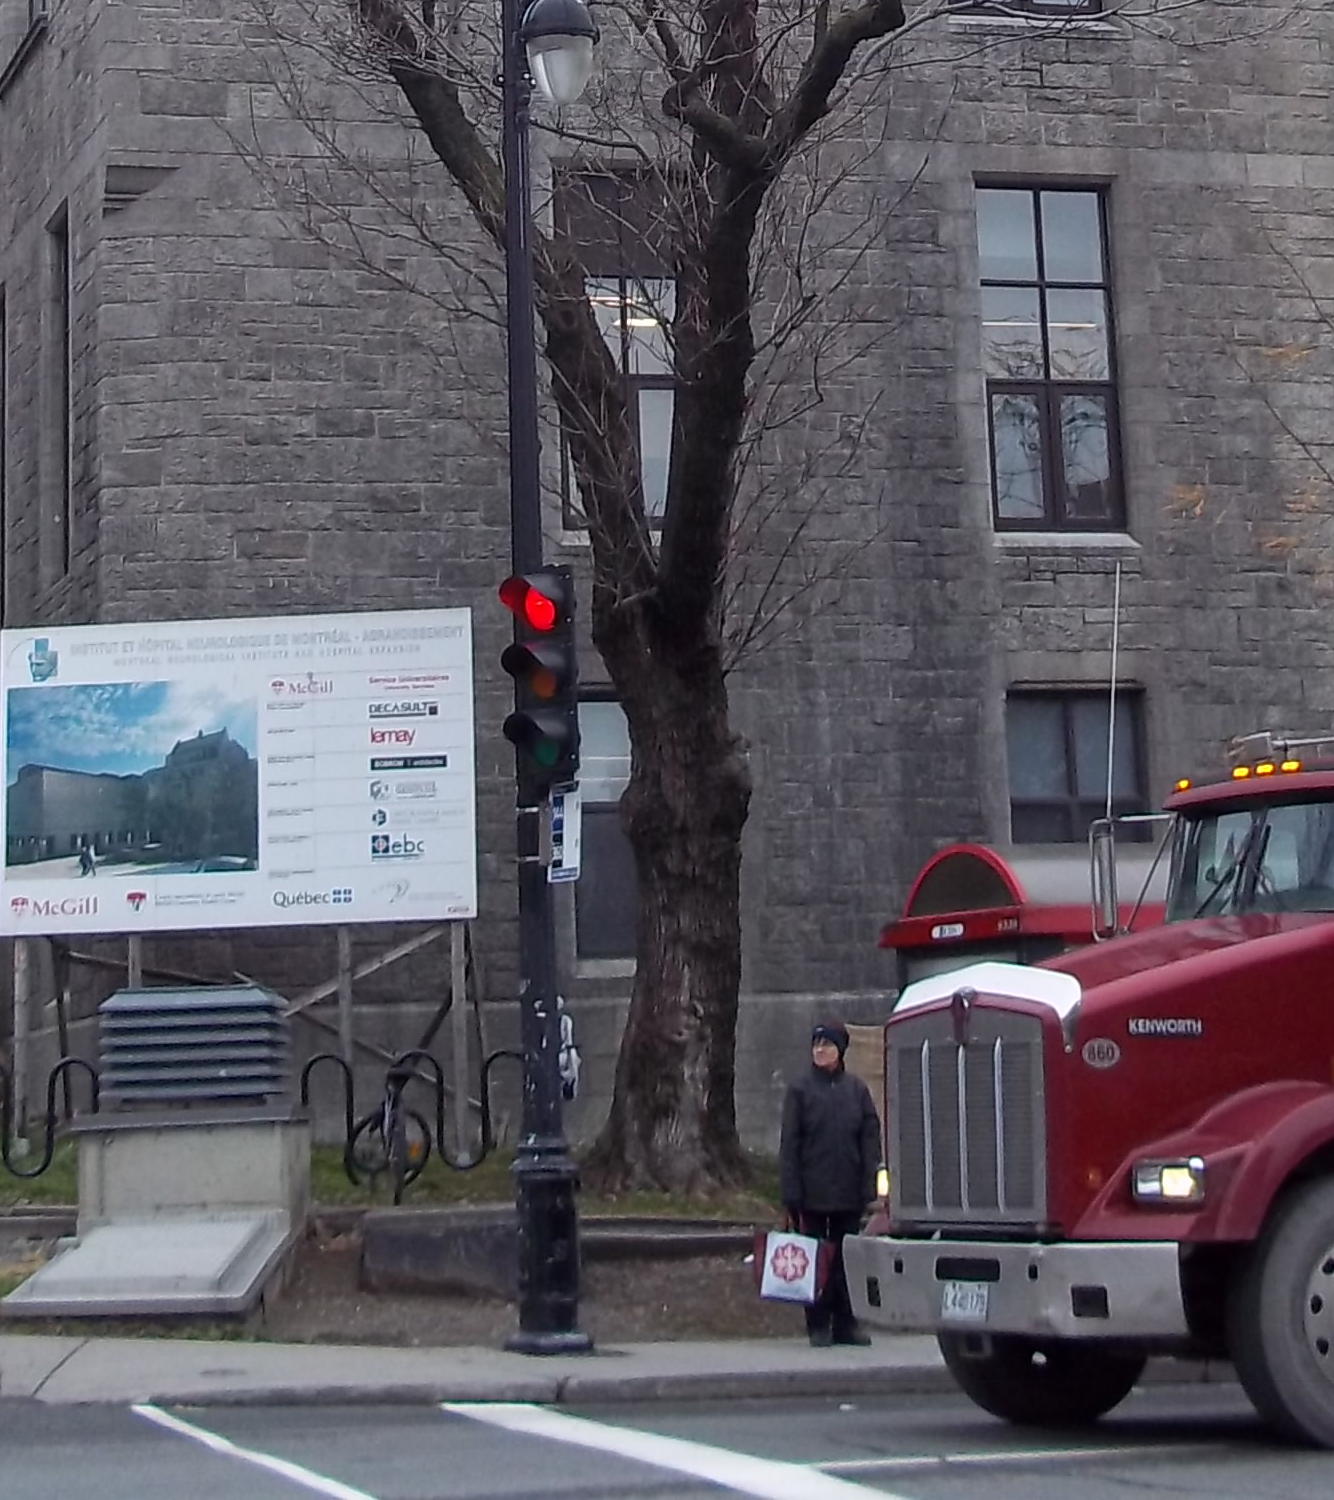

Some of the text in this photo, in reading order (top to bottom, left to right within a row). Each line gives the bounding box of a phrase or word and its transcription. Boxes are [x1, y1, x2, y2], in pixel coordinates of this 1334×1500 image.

[289, 680, 333, 694] McGill
[391, 832, 425, 854] ebc
[32, 896, 99, 916] McGill
[273, 890, 330, 908] Québec
[1128, 1017, 1203, 1036] KENWORTH
